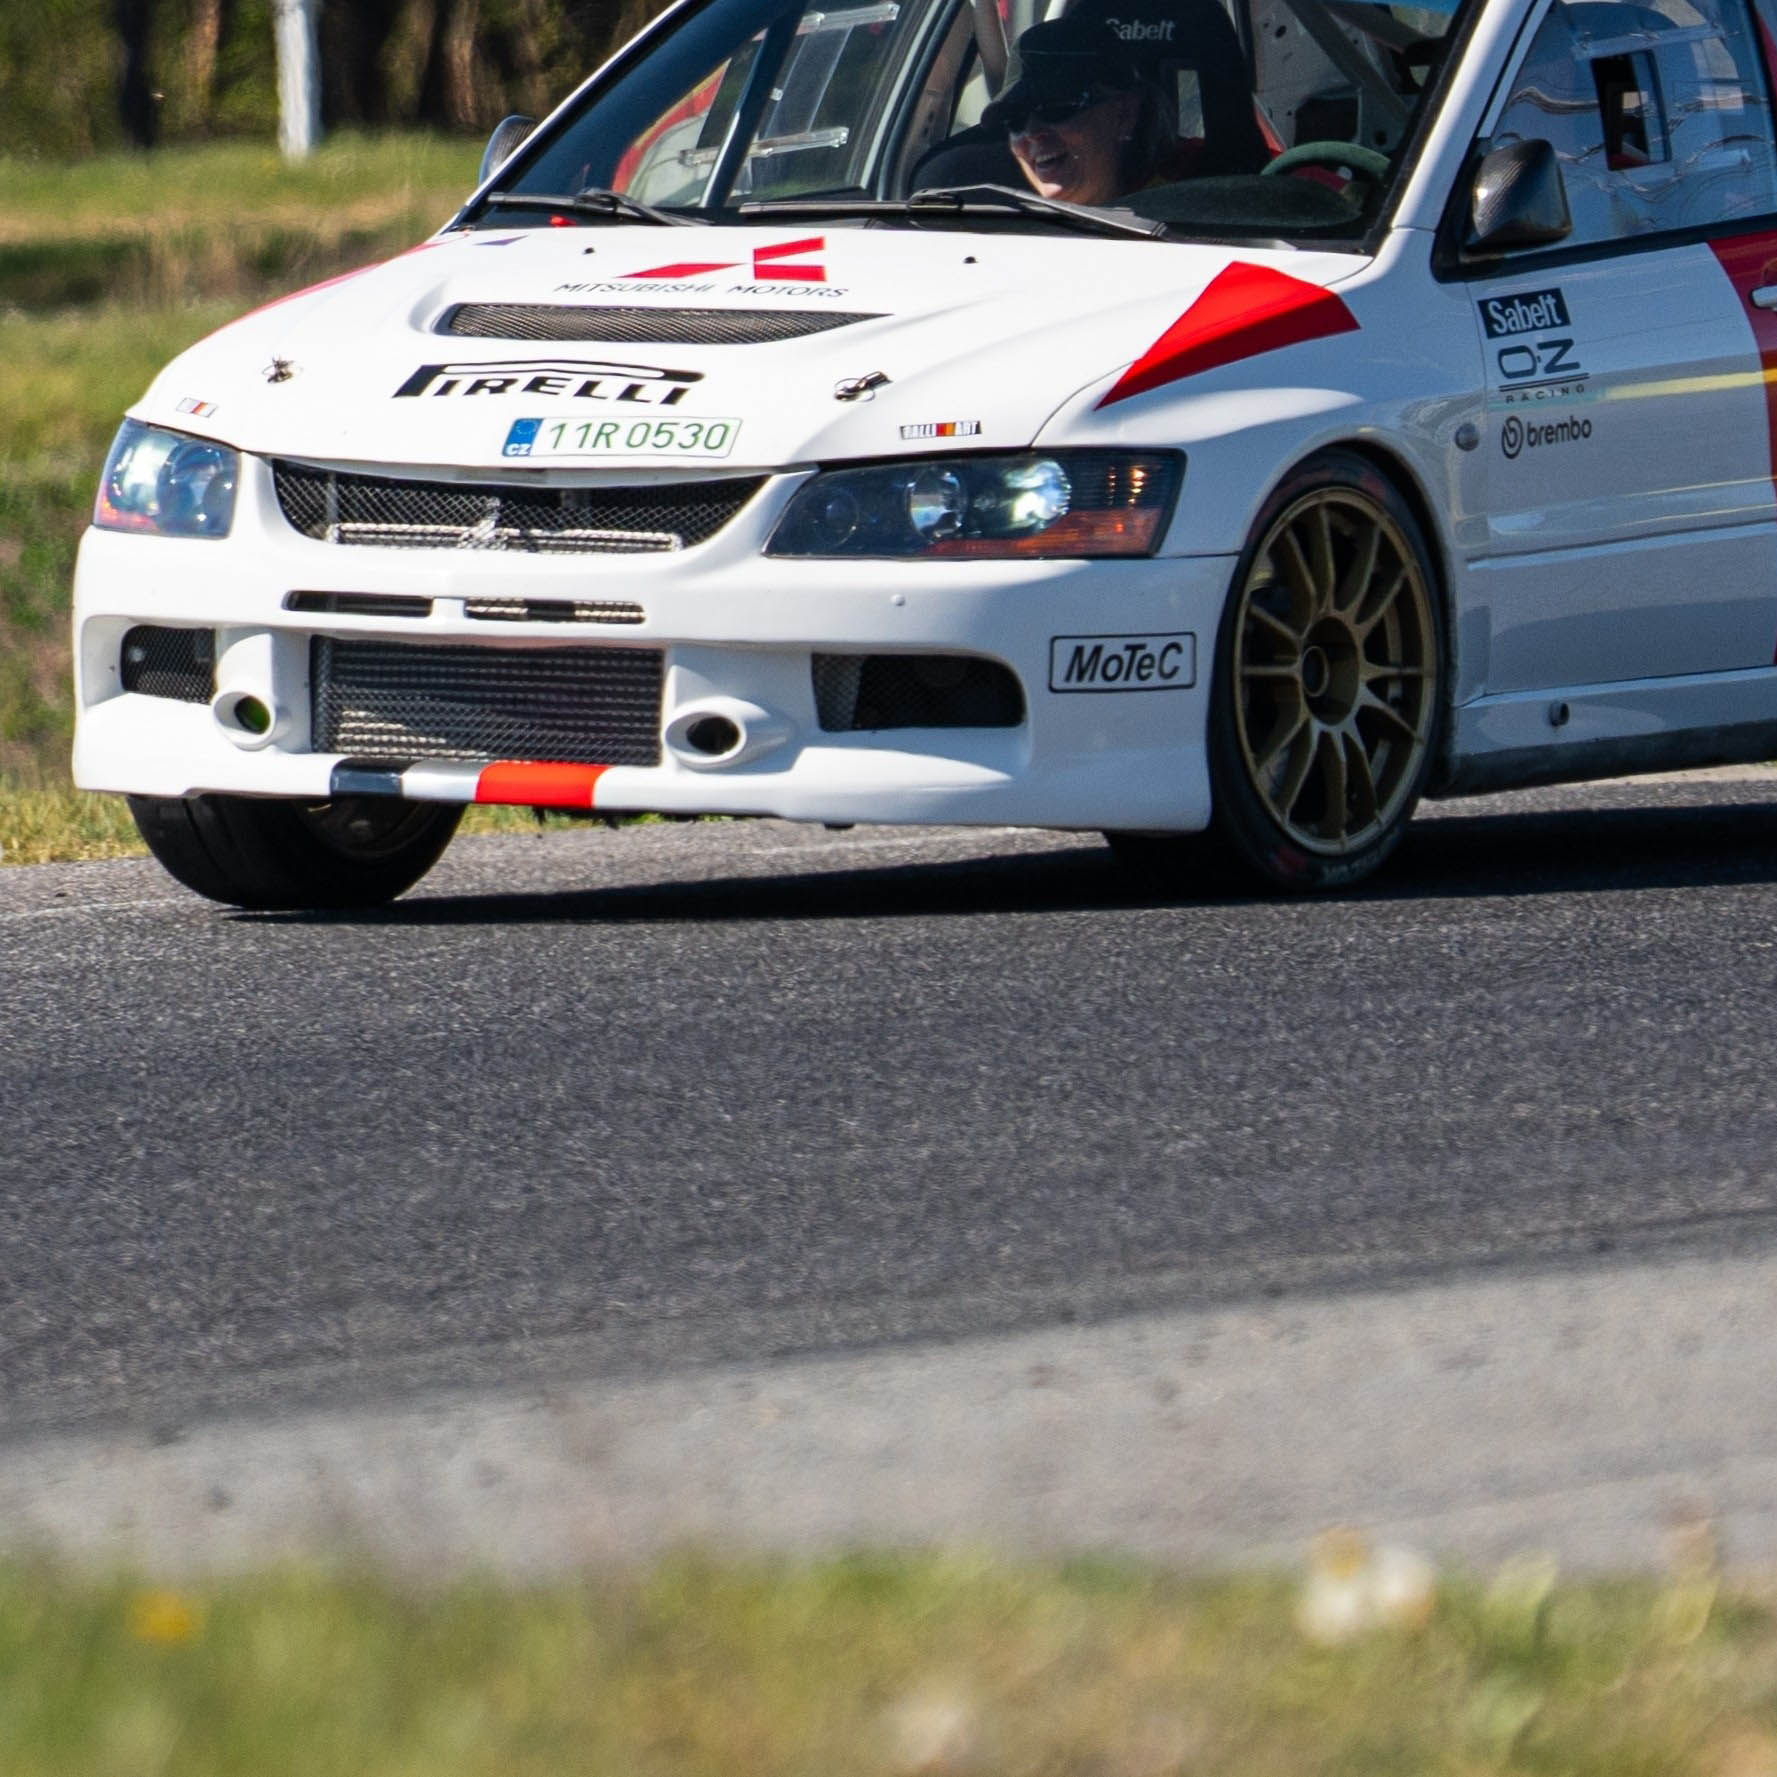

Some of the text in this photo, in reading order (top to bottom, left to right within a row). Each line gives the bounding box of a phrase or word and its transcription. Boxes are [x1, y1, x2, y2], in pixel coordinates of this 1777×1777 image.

[1105, 18, 1176, 41] Sabelt
[553, 282, 849, 298] MITSUBISHI MOTORS
[1486, 293, 1563, 335] Sabelt
[392, 359, 706, 406] PIRELLI
[1505, 383, 1586, 404] RACING
[550, 422, 731, 451] 11R 0530
[1526, 414, 1593, 448] brembo
[506, 443, 531, 456] CZ
[1064, 641, 1184, 683] MoTeC
